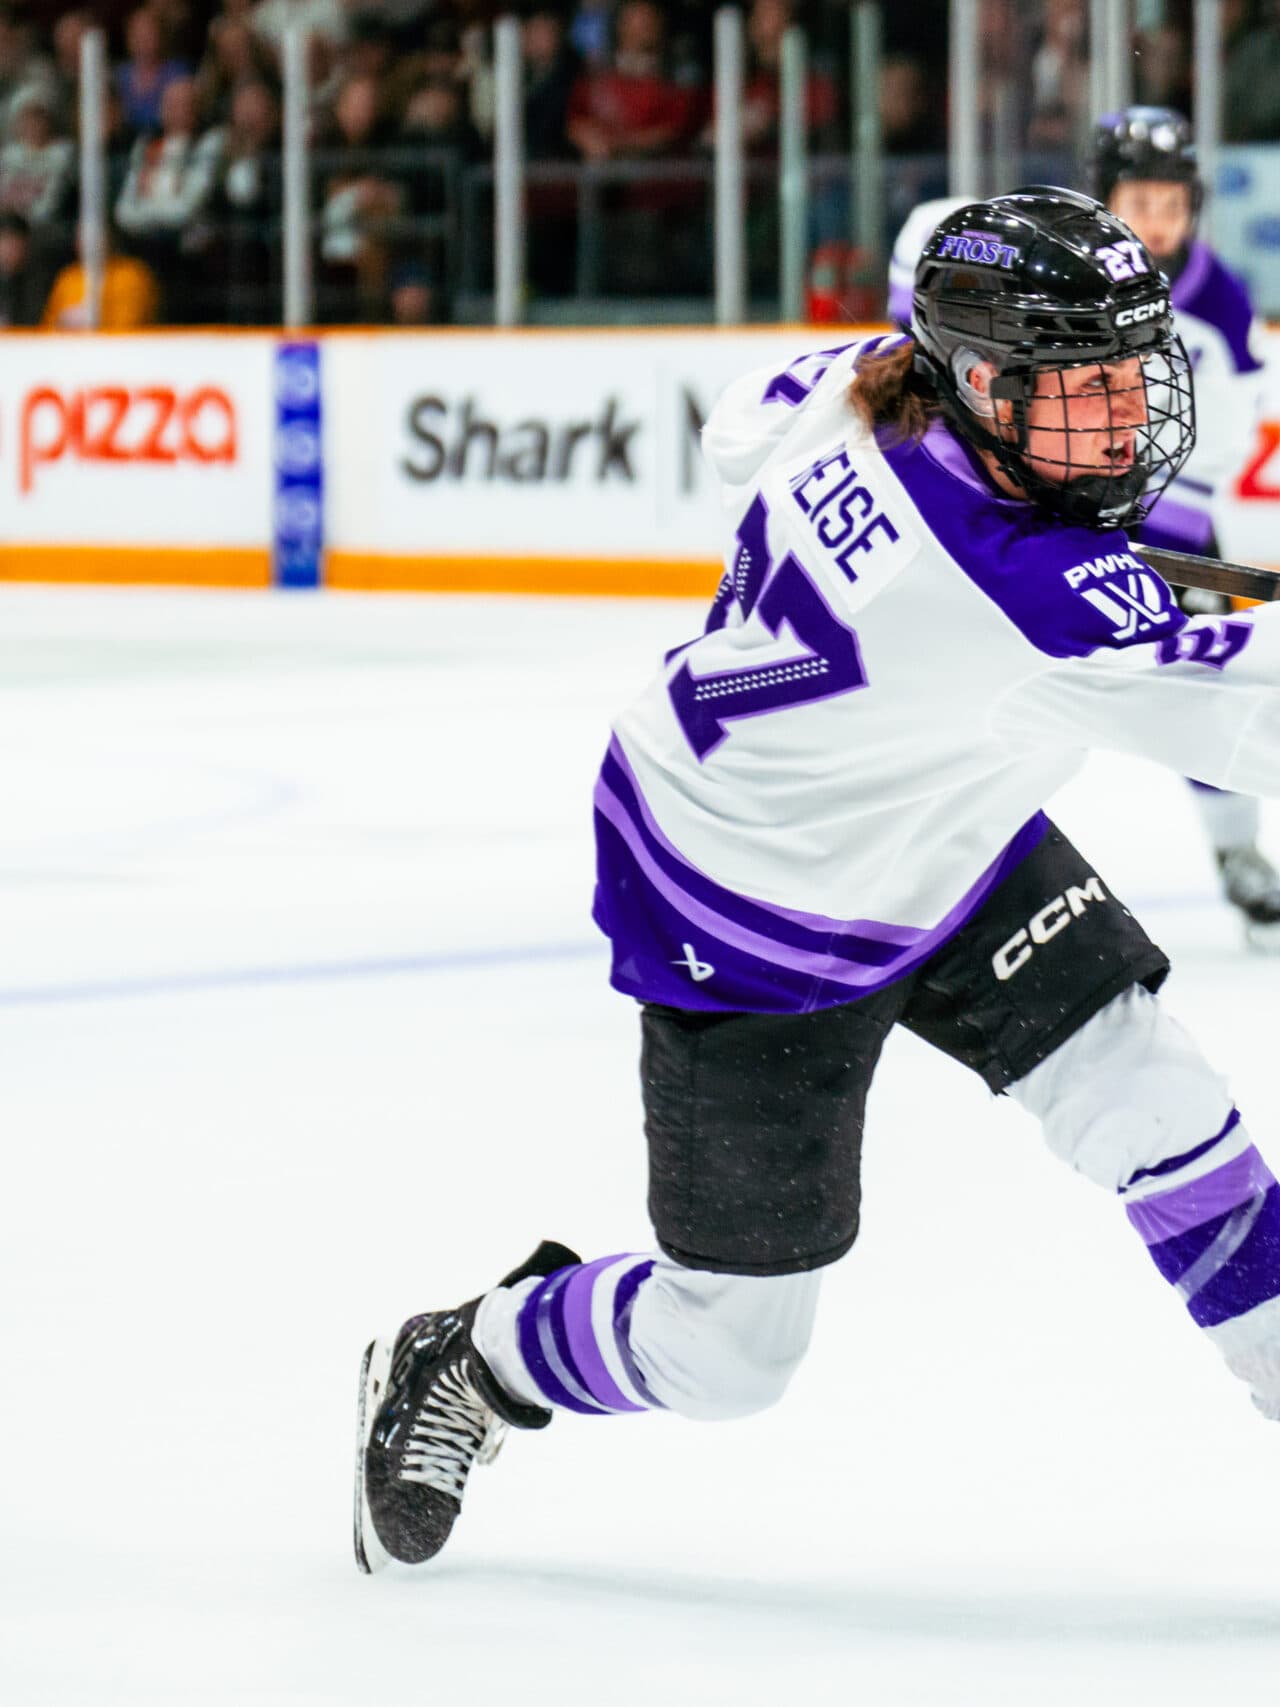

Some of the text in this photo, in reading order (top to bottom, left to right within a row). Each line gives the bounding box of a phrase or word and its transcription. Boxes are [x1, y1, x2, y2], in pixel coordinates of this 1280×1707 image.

[936, 235, 1019, 269] FROST
[1095, 240, 1149, 282] 27
[1115, 299, 1166, 327] CCM
[19, 384, 237, 496] pizza
[400, 393, 641, 483] Shark
[1063, 553, 1144, 590] PWHL
[991, 877, 1106, 981] CCM
